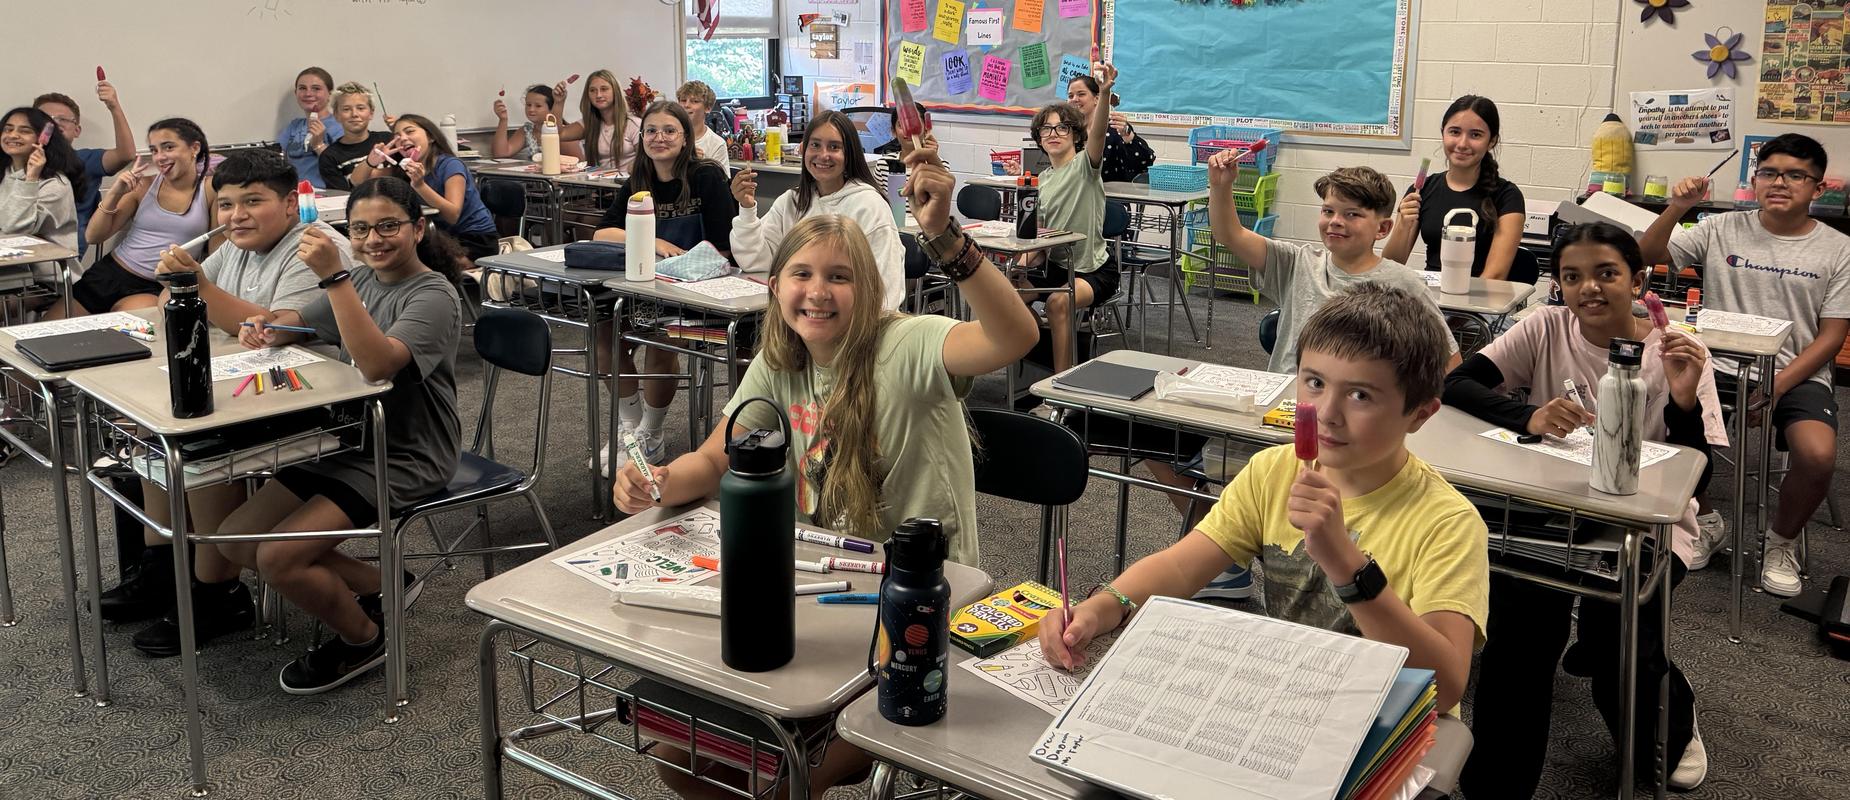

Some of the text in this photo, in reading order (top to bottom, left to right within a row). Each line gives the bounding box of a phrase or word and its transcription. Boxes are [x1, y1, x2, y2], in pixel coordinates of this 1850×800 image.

[811, 33, 834, 41] taylor
[903, 46, 921, 56] words
[831, 96, 864, 109] Taylor
[1638, 106, 1666, 114] Empathy
[1685, 103, 1709, 113] attempt
[1718, 104, 1729, 112] put
[1638, 114, 1663, 123] yourself
[1022, 196, 1035, 211] G
[1726, 254, 1821, 280] Champion
[634, 451, 650, 477] MARKERS
[839, 561, 867, 569] MARKERS
[1021, 590, 1057, 607] Crayola
[966, 607, 1011, 631] PENCILS
[973, 603, 1024, 628] COLORED
[958, 623, 976, 632] 24
[890, 661, 917, 672] MERCURY
[923, 693, 940, 703] EARTH
